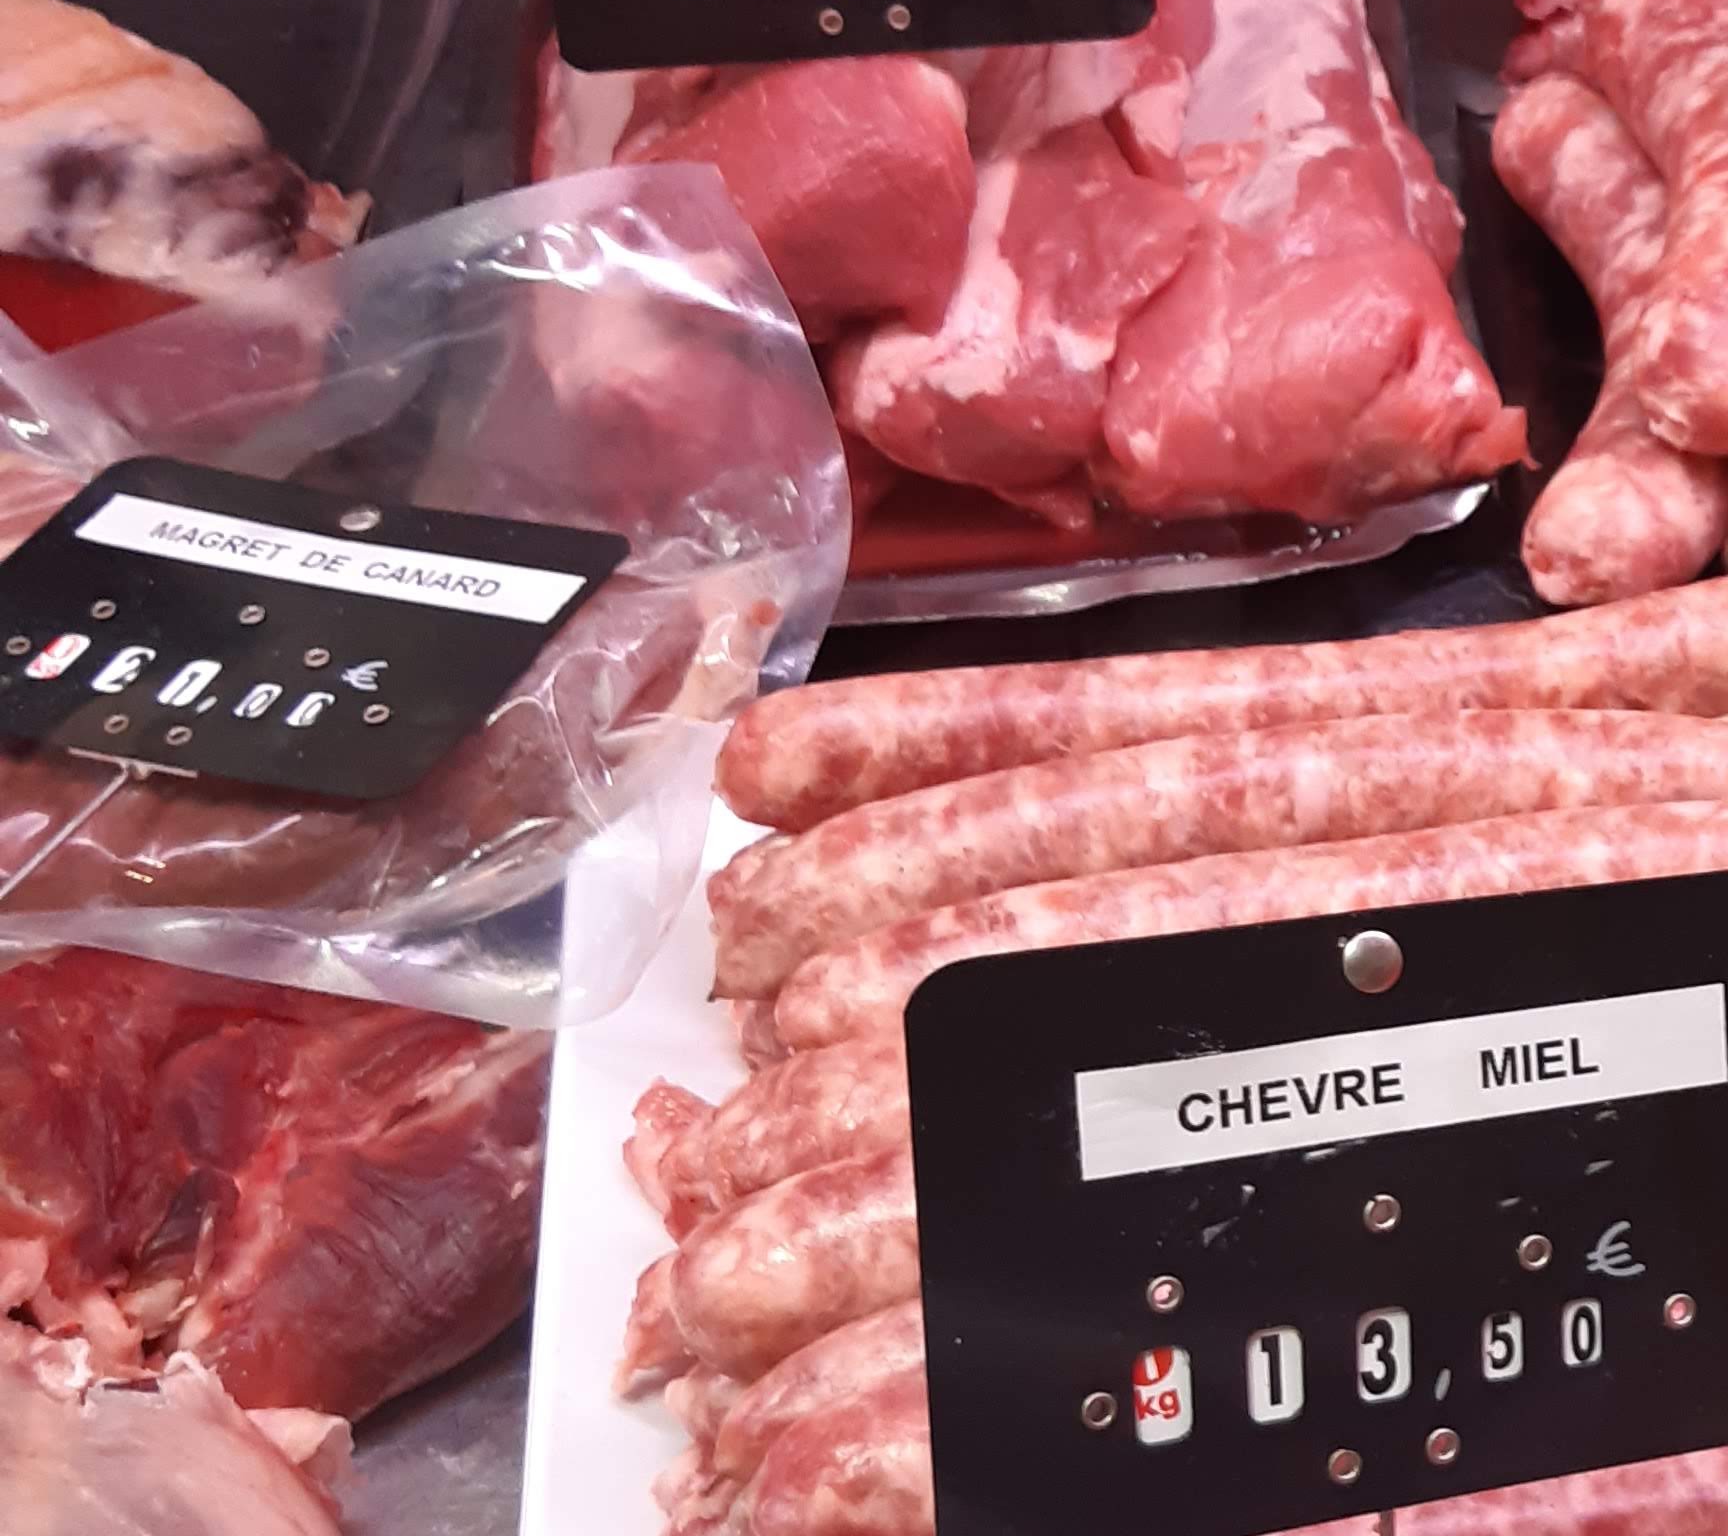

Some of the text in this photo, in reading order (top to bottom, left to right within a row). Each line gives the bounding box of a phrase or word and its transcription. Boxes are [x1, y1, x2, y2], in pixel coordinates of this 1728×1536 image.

[150, 520, 501, 600] MAGRET DE CANARD
[341, 661, 389, 691] €
[1177, 1036, 1600, 1136] CHEVRE MIEL
[1587, 1222, 1646, 1278] €
[1258, 1301, 1601, 1410] 13,50
[1134, 1389, 1181, 1424] kg
